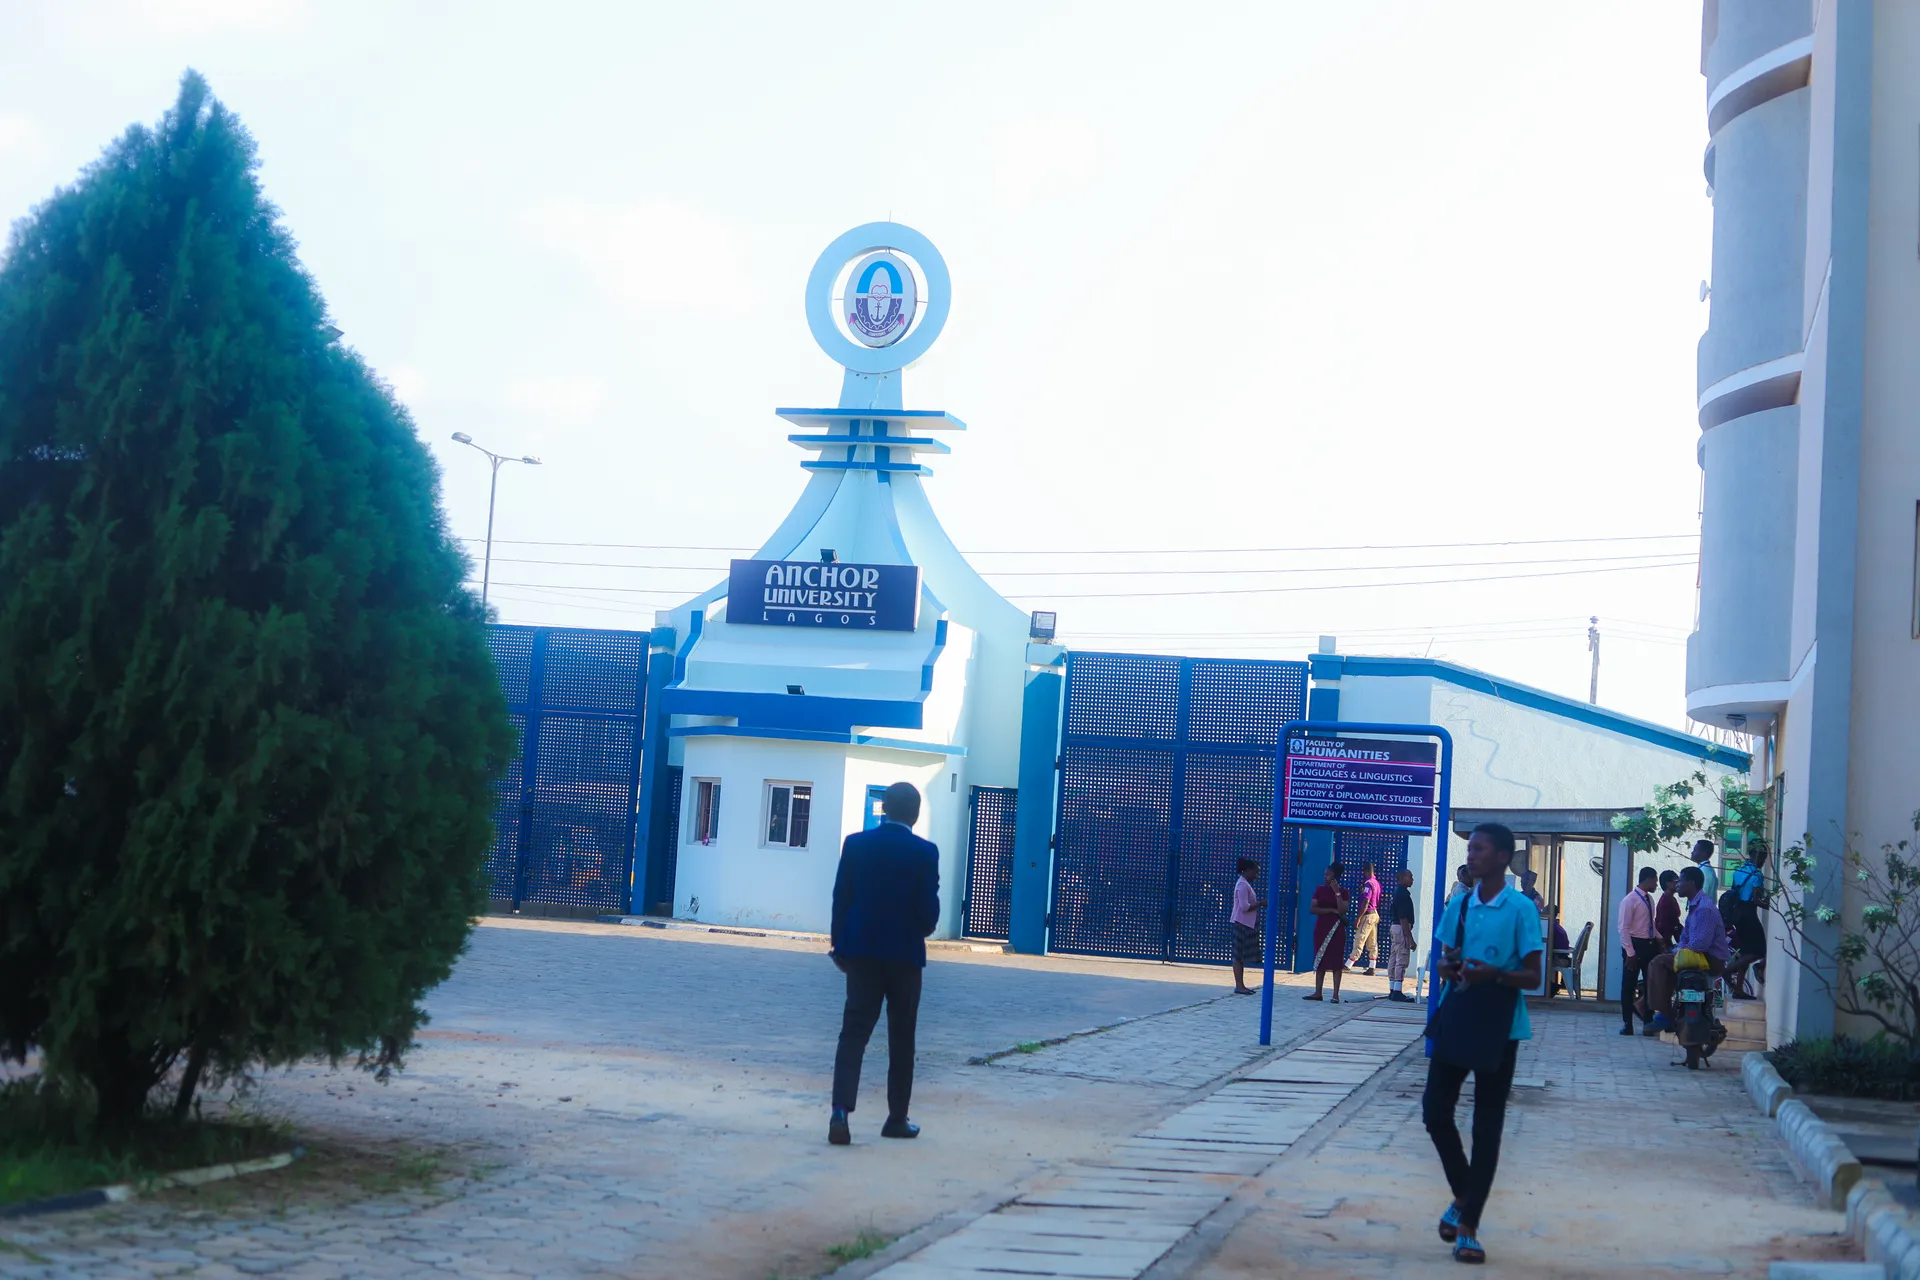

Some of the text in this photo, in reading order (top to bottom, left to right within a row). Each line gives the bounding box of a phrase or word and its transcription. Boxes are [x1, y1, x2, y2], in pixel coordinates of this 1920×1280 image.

[765, 564, 880, 589] ANCHOR
[764, 588, 877, 607] UNIVERSITY
[764, 611, 875, 625] LAGOS
[1305, 747, 1390, 761] HUMANITIES
[1293, 768, 1348, 778] LANGUAGES
[1359, 773, 1413, 782] LINGUISTICS
[1292, 789, 1327, 798] HISTORY
[1336, 792, 1387, 802] DIPLOMATIC
[1389, 795, 1423, 804] STUDIES
[1291, 809, 1339, 818] PHILOSOPHY
[1348, 812, 1388, 821] RELIGIOUS
[1390, 815, 1421, 823] STUDIES
